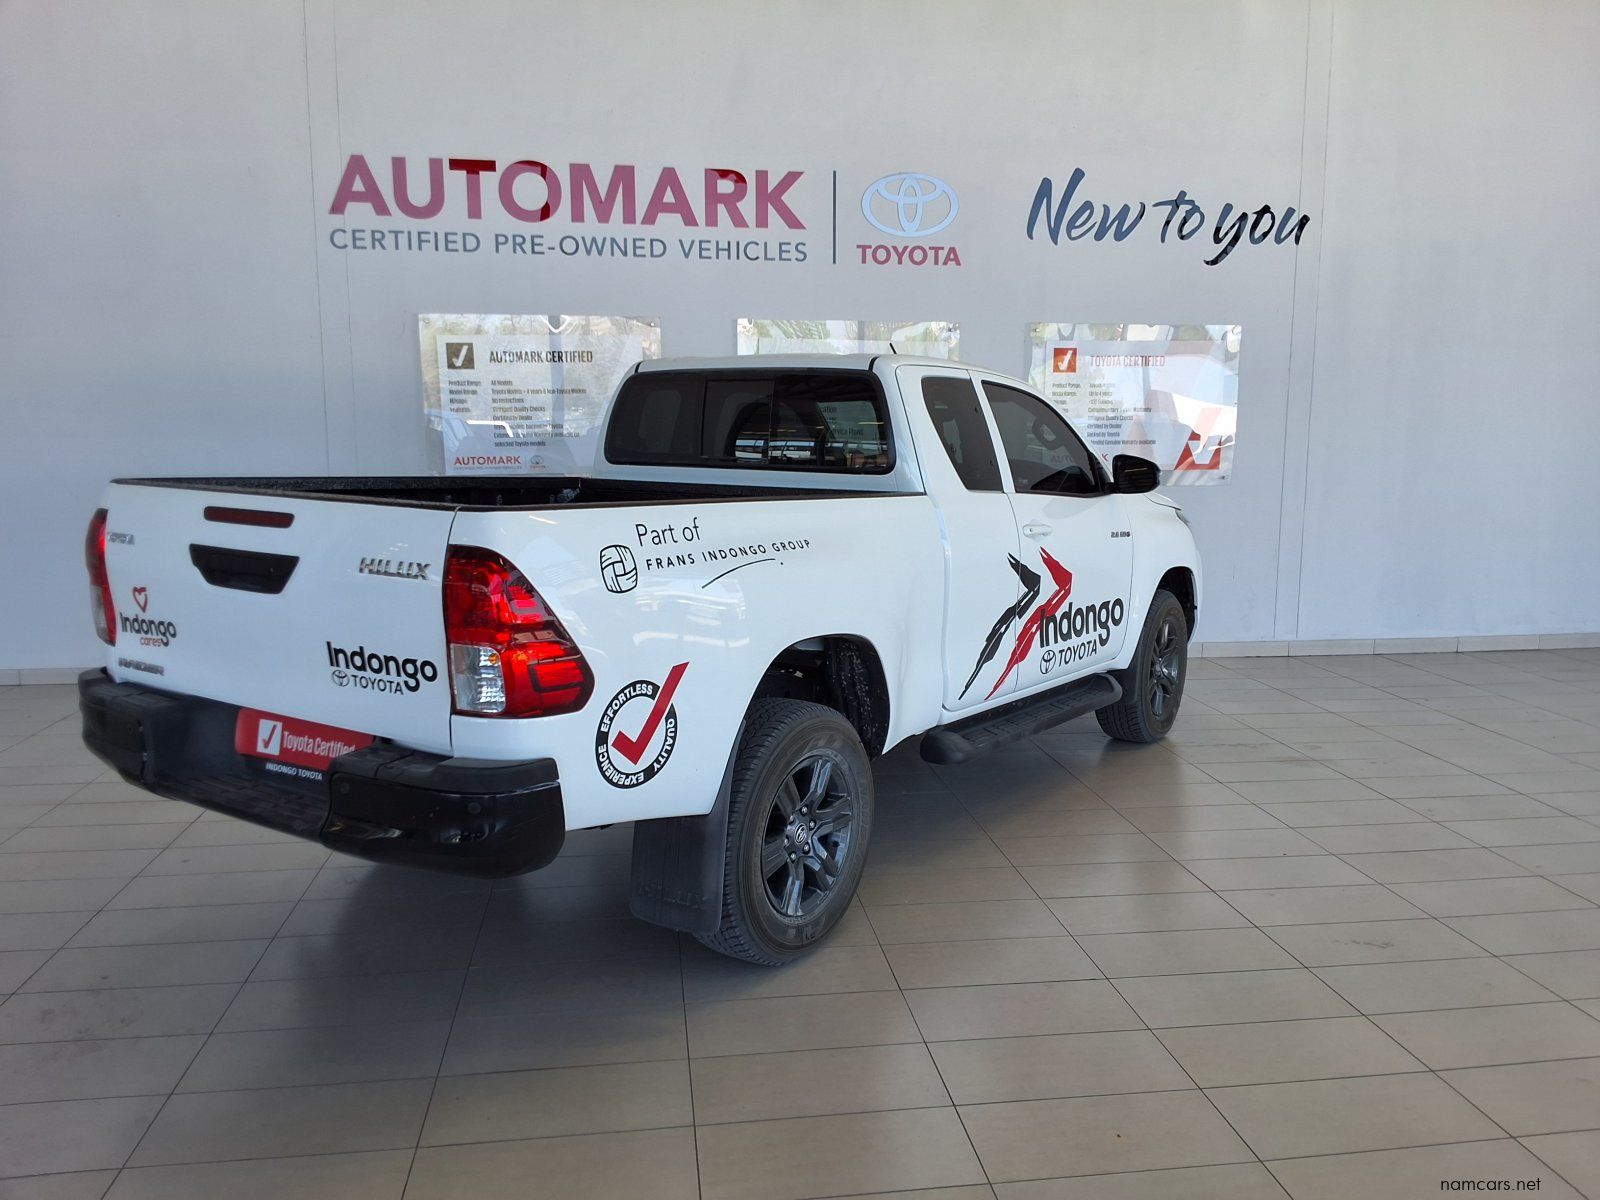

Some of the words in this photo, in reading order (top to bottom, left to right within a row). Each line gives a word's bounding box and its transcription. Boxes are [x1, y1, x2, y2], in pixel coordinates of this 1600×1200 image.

[328, 154, 807, 231] AUTOMARK
[1026, 167, 1146, 246] New
[1152, 190, 1206, 243] to
[1203, 202, 1311, 266] you
[329, 228, 481, 254] CERTIFIED
[494, 234, 668, 260] PRE-OWNED
[678, 239, 809, 263] VEHICLES
[856, 244, 962, 267] TOYOTA
[489, 351, 544, 364] AUTOMARK
[545, 350, 593, 363] CERTIFIED
[1090, 355, 1121, 367] TOYOTA
[1124, 356, 1165, 367] CERTIFIED
[454, 455, 521, 466] AUTOMARK
[635, 523, 678, 547] Part
[682, 517, 701, 541] of
[359, 557, 431, 580] HILUX
[646, 553, 696, 571] FRANS
[702, 544, 767, 562] INDONGO
[771, 539, 811, 553] GROUP
[119, 612, 177, 647] Indongo
[1039, 597, 1125, 648] Indongo
[140, 636, 161, 647] cares
[1058, 638, 1097, 667] TOYOTA
[326, 641, 438, 692] Indongo
[351, 675, 404, 695] TOYOTA
[600, 683, 653, 733] EFFORTLESS
[283, 731, 313, 754] Toyota
[652, 718, 676, 772] QUALITY
[265, 762, 297, 776] INDONGO
[298, 768, 323, 780] TOYOTA
[598, 743, 645, 786] EXPERIENCE
